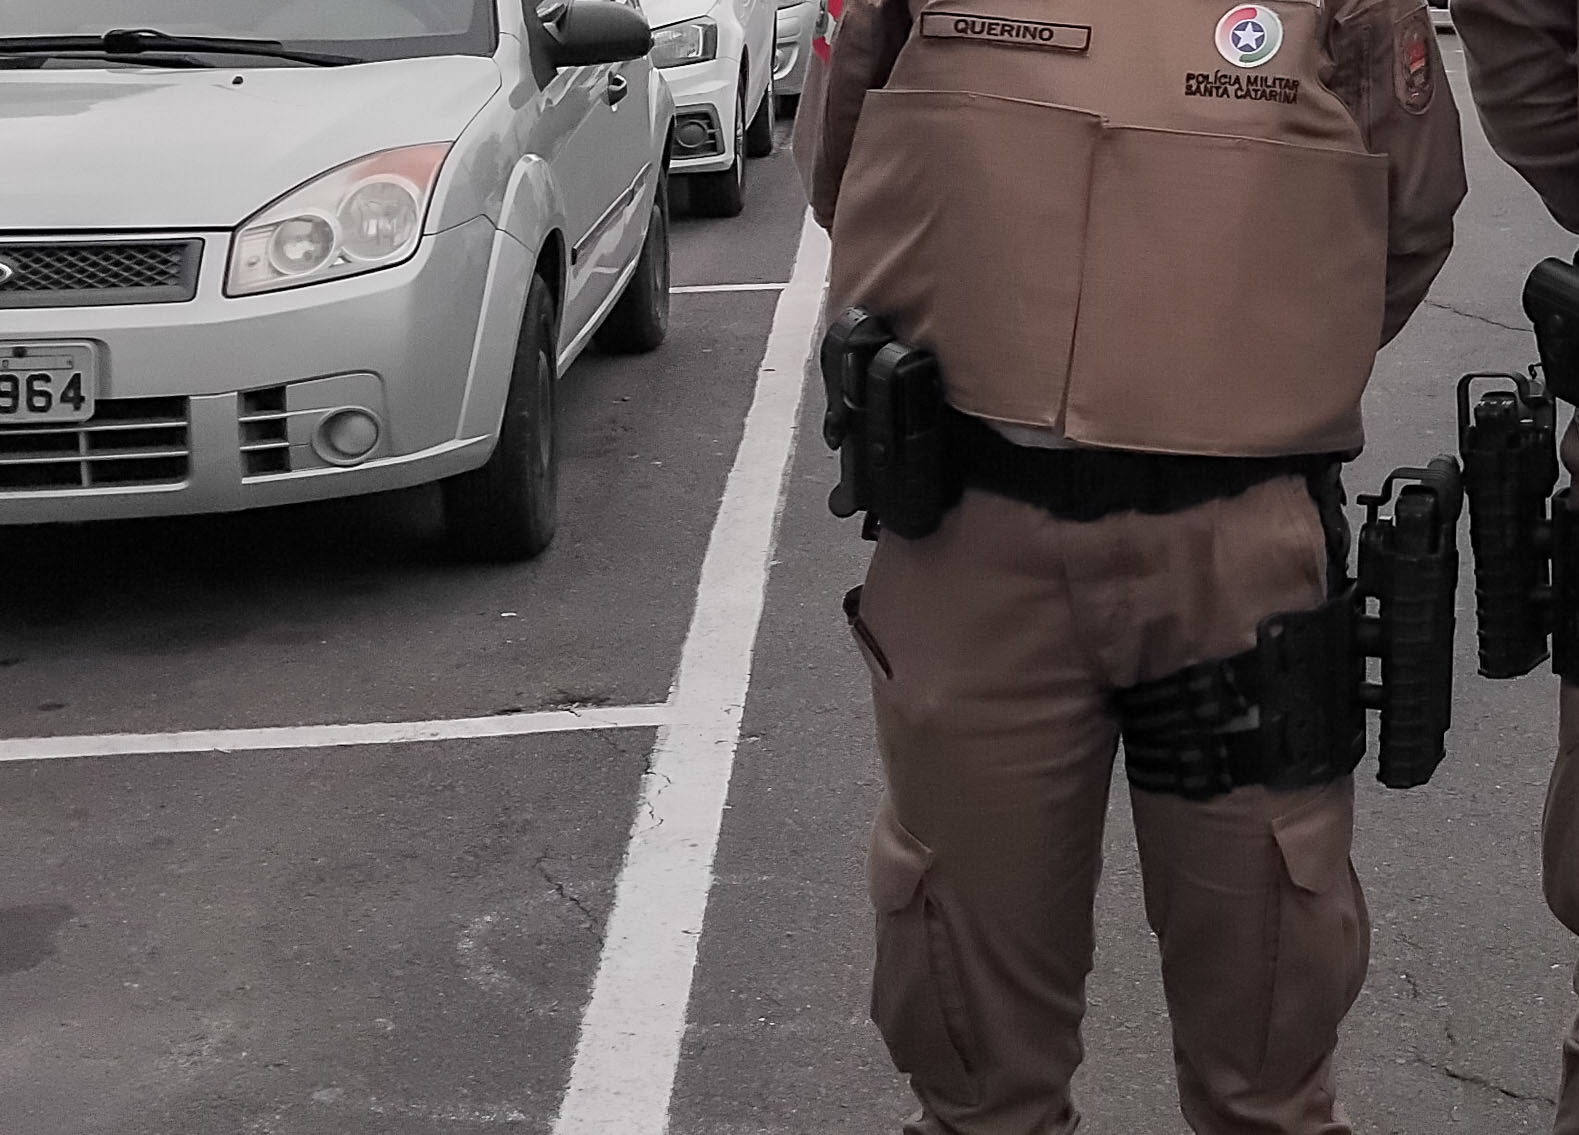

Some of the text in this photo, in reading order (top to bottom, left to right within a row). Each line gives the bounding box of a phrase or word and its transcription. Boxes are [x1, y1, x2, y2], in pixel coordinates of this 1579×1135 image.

[954, 18, 1055, 42] QUERINO
[1185, 69, 1299, 92] POLÍCIA MILITAR
[1185, 84, 1298, 104] SANTA CATARINA
